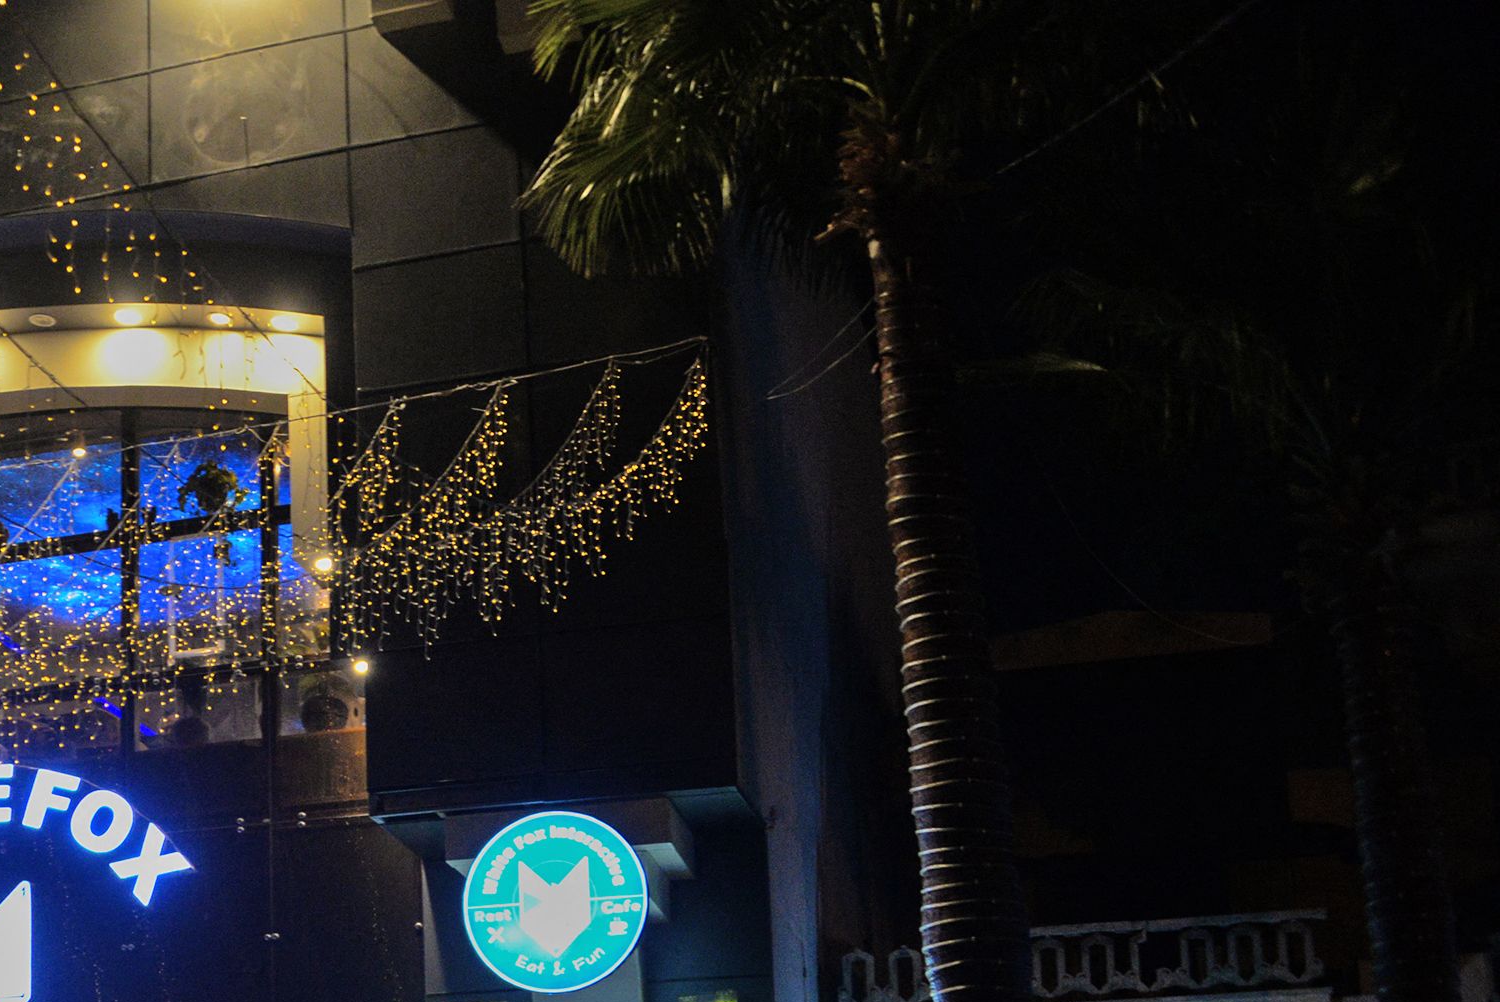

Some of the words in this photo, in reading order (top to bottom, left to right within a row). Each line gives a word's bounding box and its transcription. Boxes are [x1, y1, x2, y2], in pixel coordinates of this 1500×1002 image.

[22, 768, 195, 906] FOX
[601, 899, 641, 914] Cafe
[515, 954, 545, 975] Eat
[552, 960, 565, 976] &
[572, 947, 605, 971] Fun
